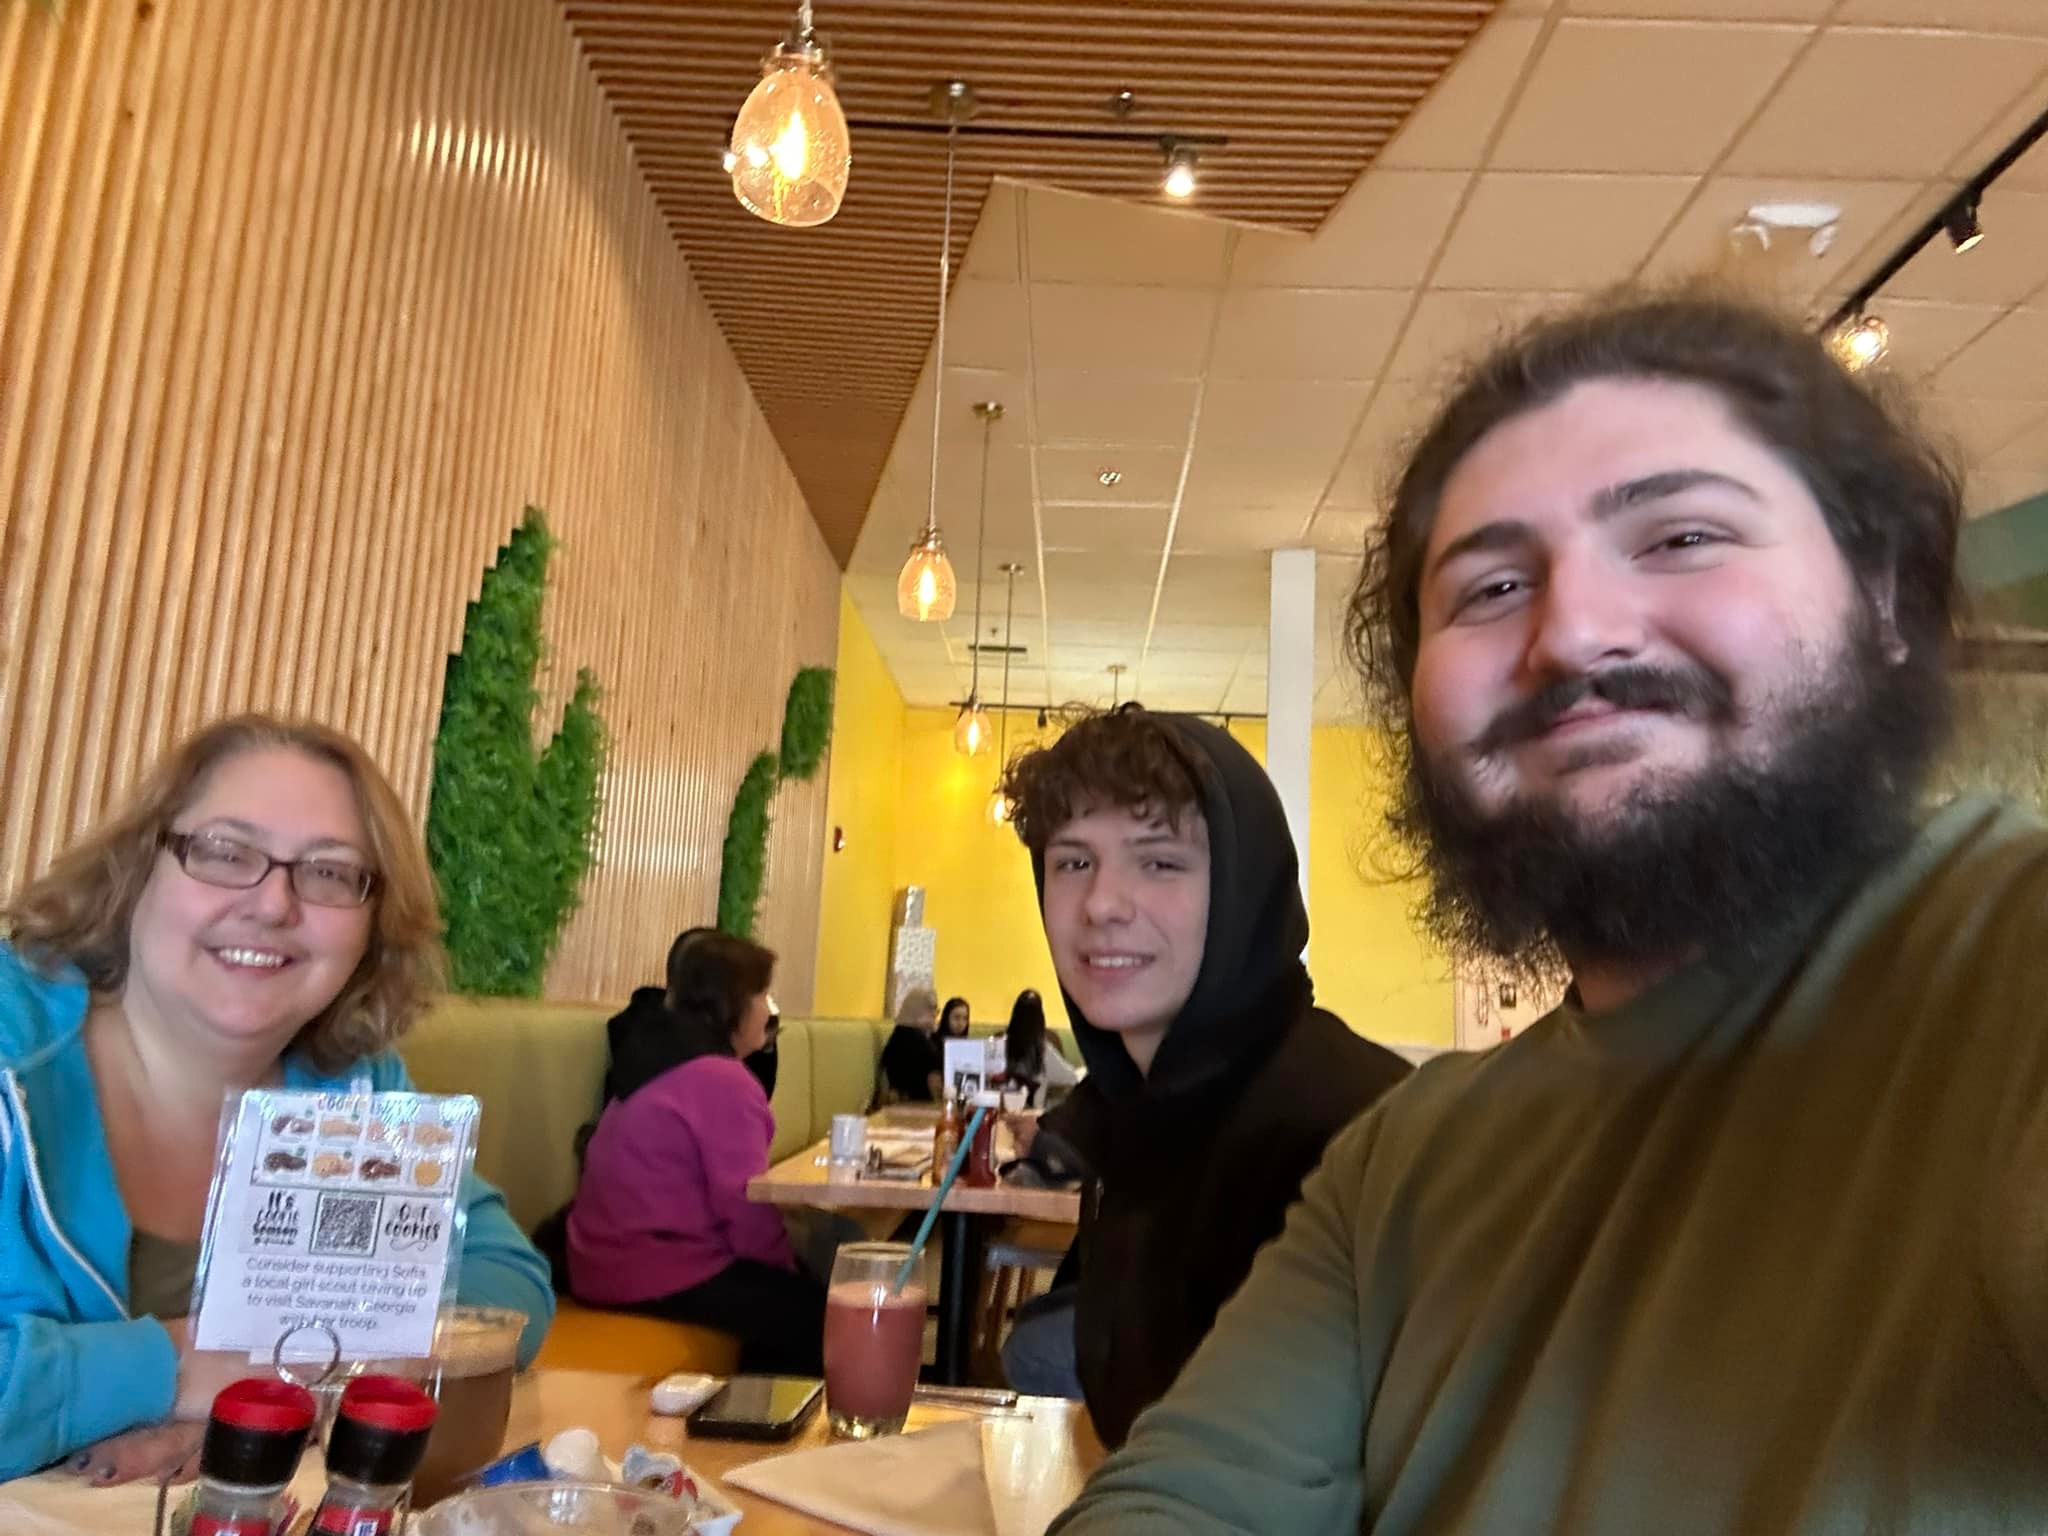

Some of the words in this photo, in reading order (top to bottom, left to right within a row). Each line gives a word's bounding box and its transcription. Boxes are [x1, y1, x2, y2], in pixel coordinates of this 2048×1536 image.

[246, 1257, 310, 1273] Consider
[312, 1262, 389, 1279] supporting
[254, 1275, 291, 1290] local
